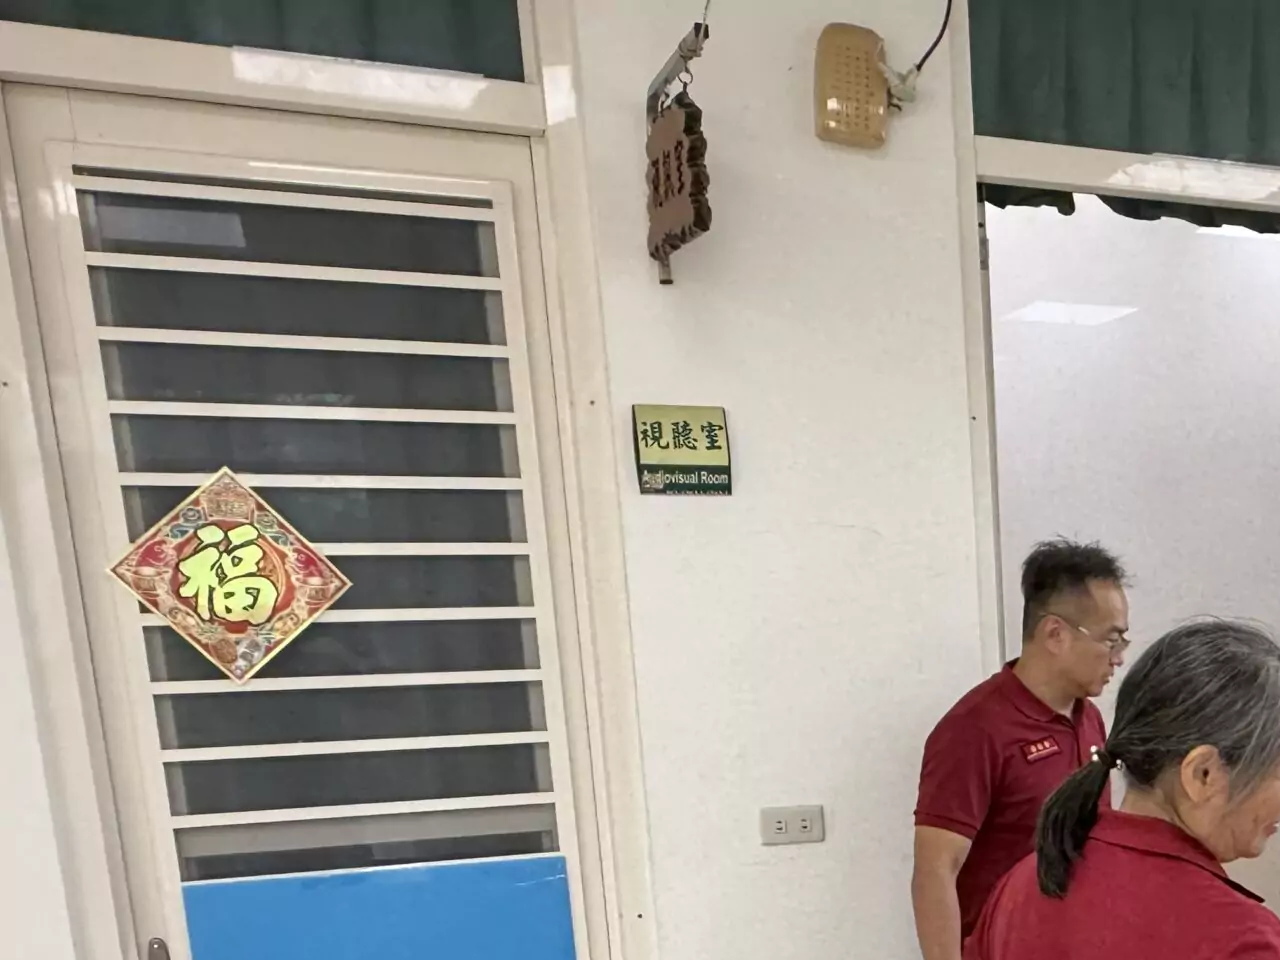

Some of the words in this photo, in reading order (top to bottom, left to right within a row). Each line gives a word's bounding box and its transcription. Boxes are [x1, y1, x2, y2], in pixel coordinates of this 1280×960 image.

[640, 421, 724, 450] 視聽室
[700, 471, 729, 484] Room
[178, 523, 278, 627] 福
